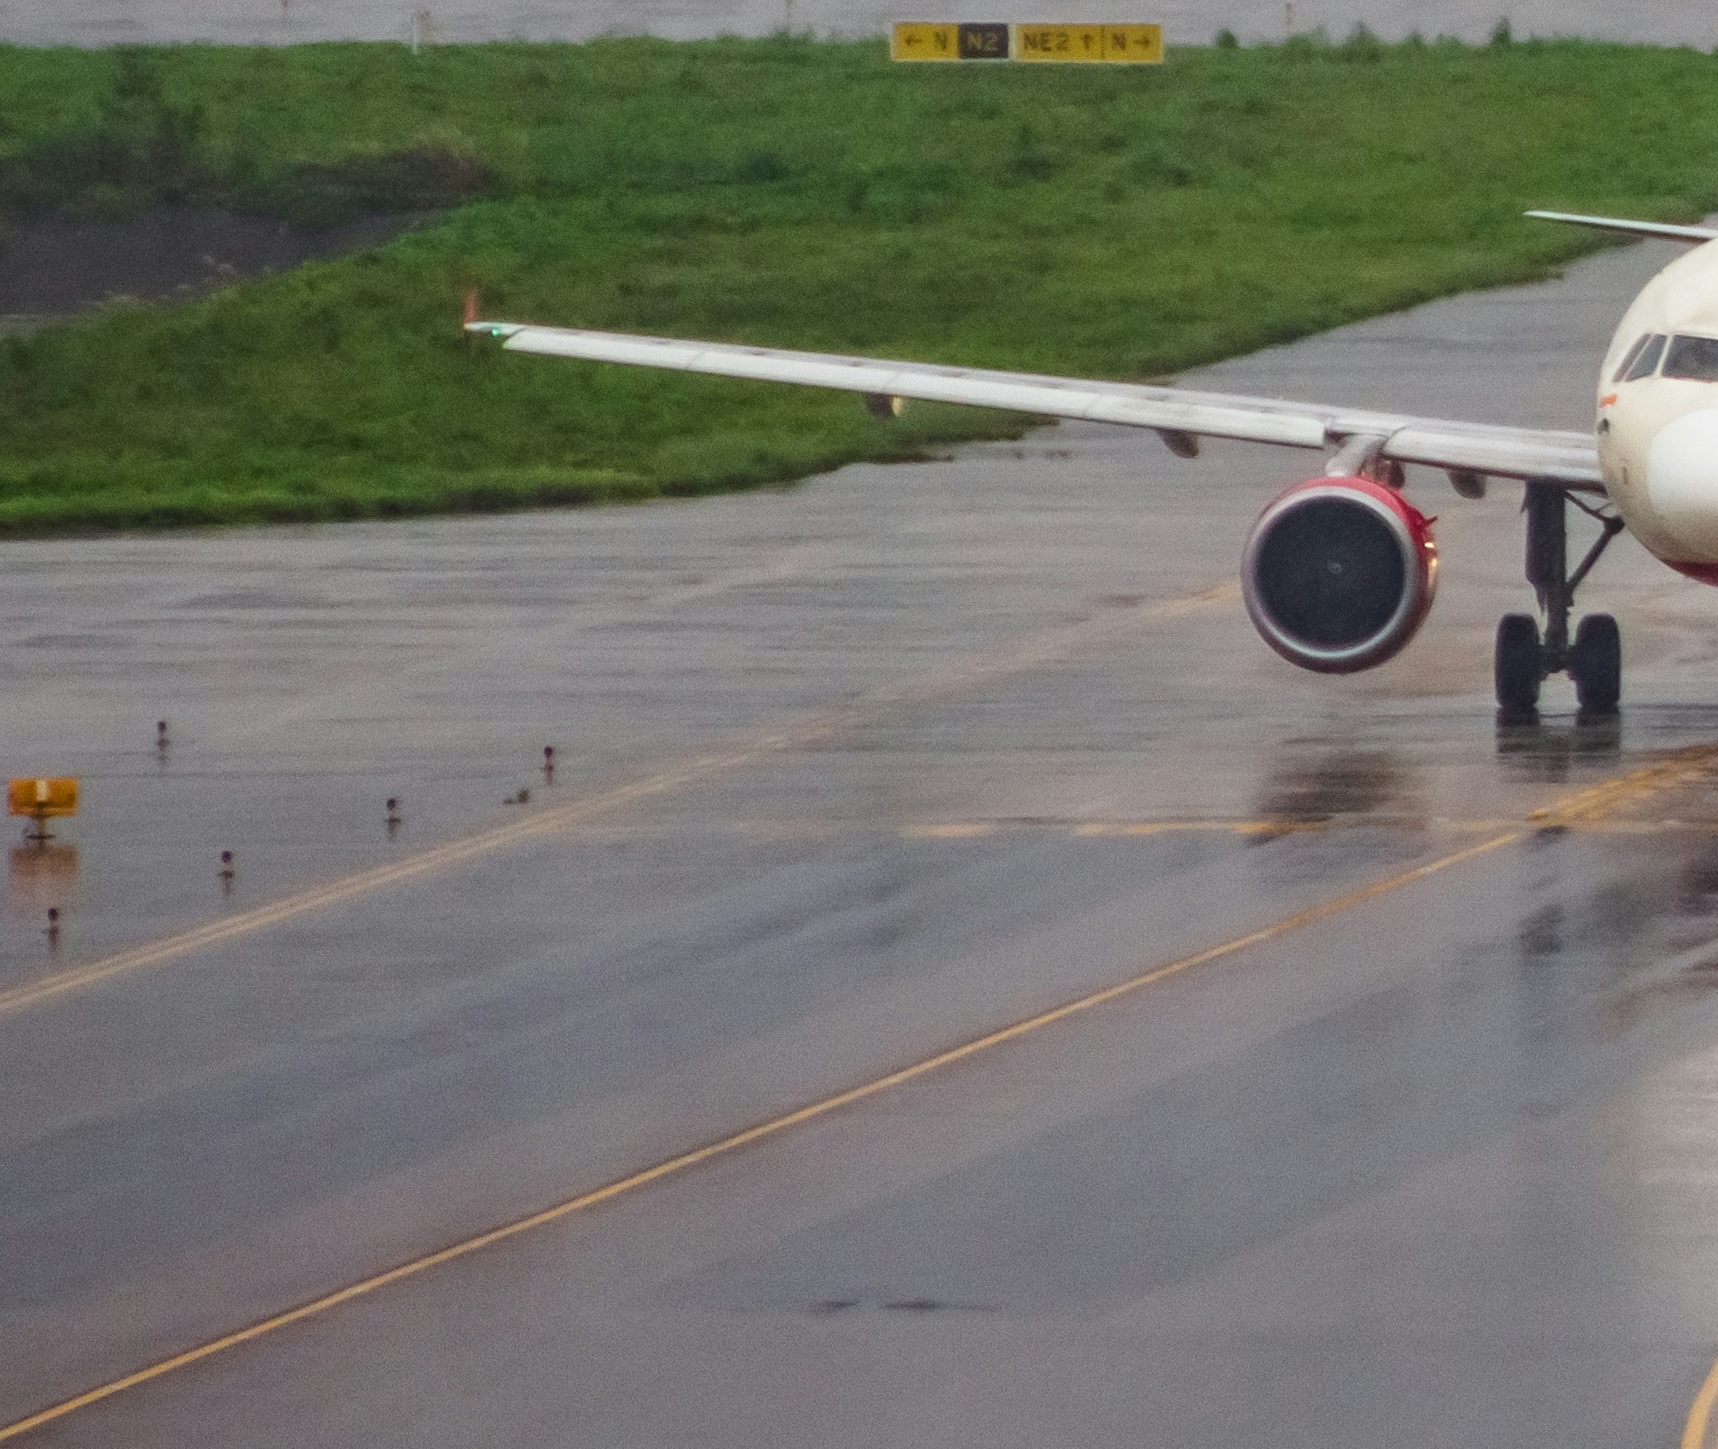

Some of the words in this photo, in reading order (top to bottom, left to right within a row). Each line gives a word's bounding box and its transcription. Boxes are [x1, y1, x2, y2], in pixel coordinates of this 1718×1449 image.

[966, 31, 999, 52] N2
[1023, 31, 1069, 52] NE2
[1111, 31, 1127, 51] N
